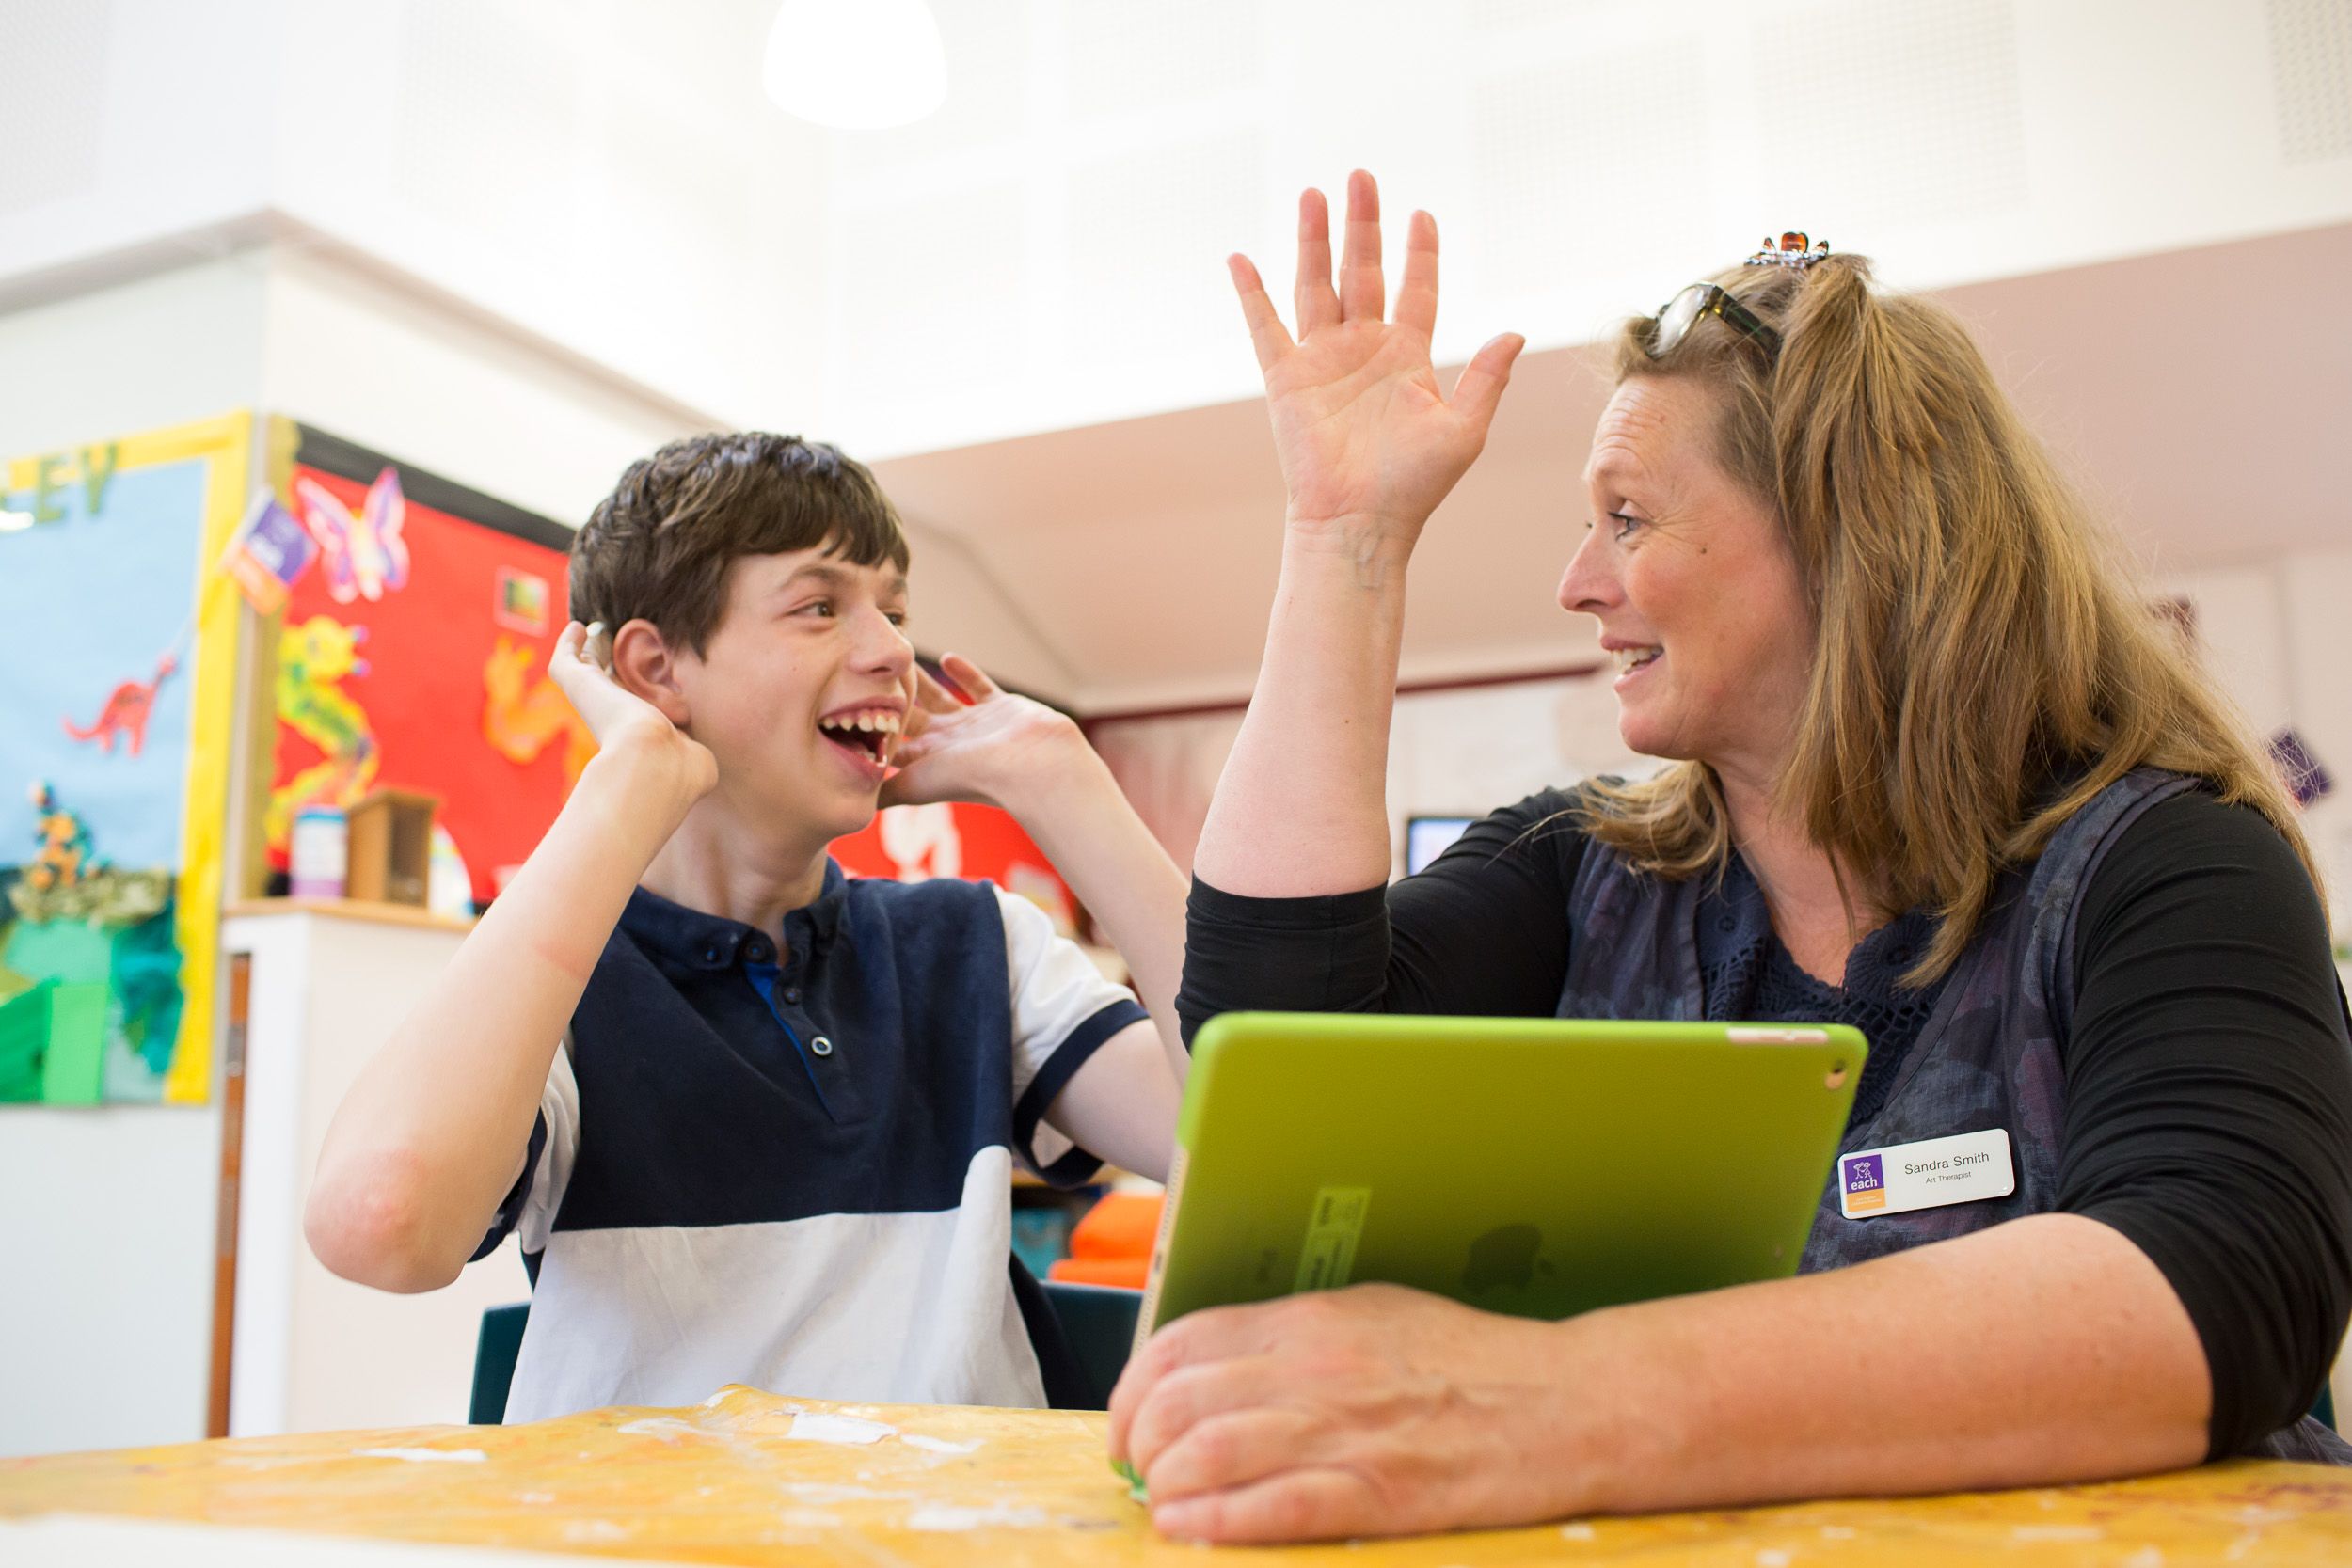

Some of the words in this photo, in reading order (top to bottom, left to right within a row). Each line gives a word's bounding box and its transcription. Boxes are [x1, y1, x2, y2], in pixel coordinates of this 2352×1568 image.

[0, 443, 119, 525] EV
[1904, 1160, 1949, 1175] Sandra
[1953, 1152, 1990, 1167] Smith
[1851, 1176, 1878, 1191] each
[1938, 1171, 1972, 1182] Therapist
